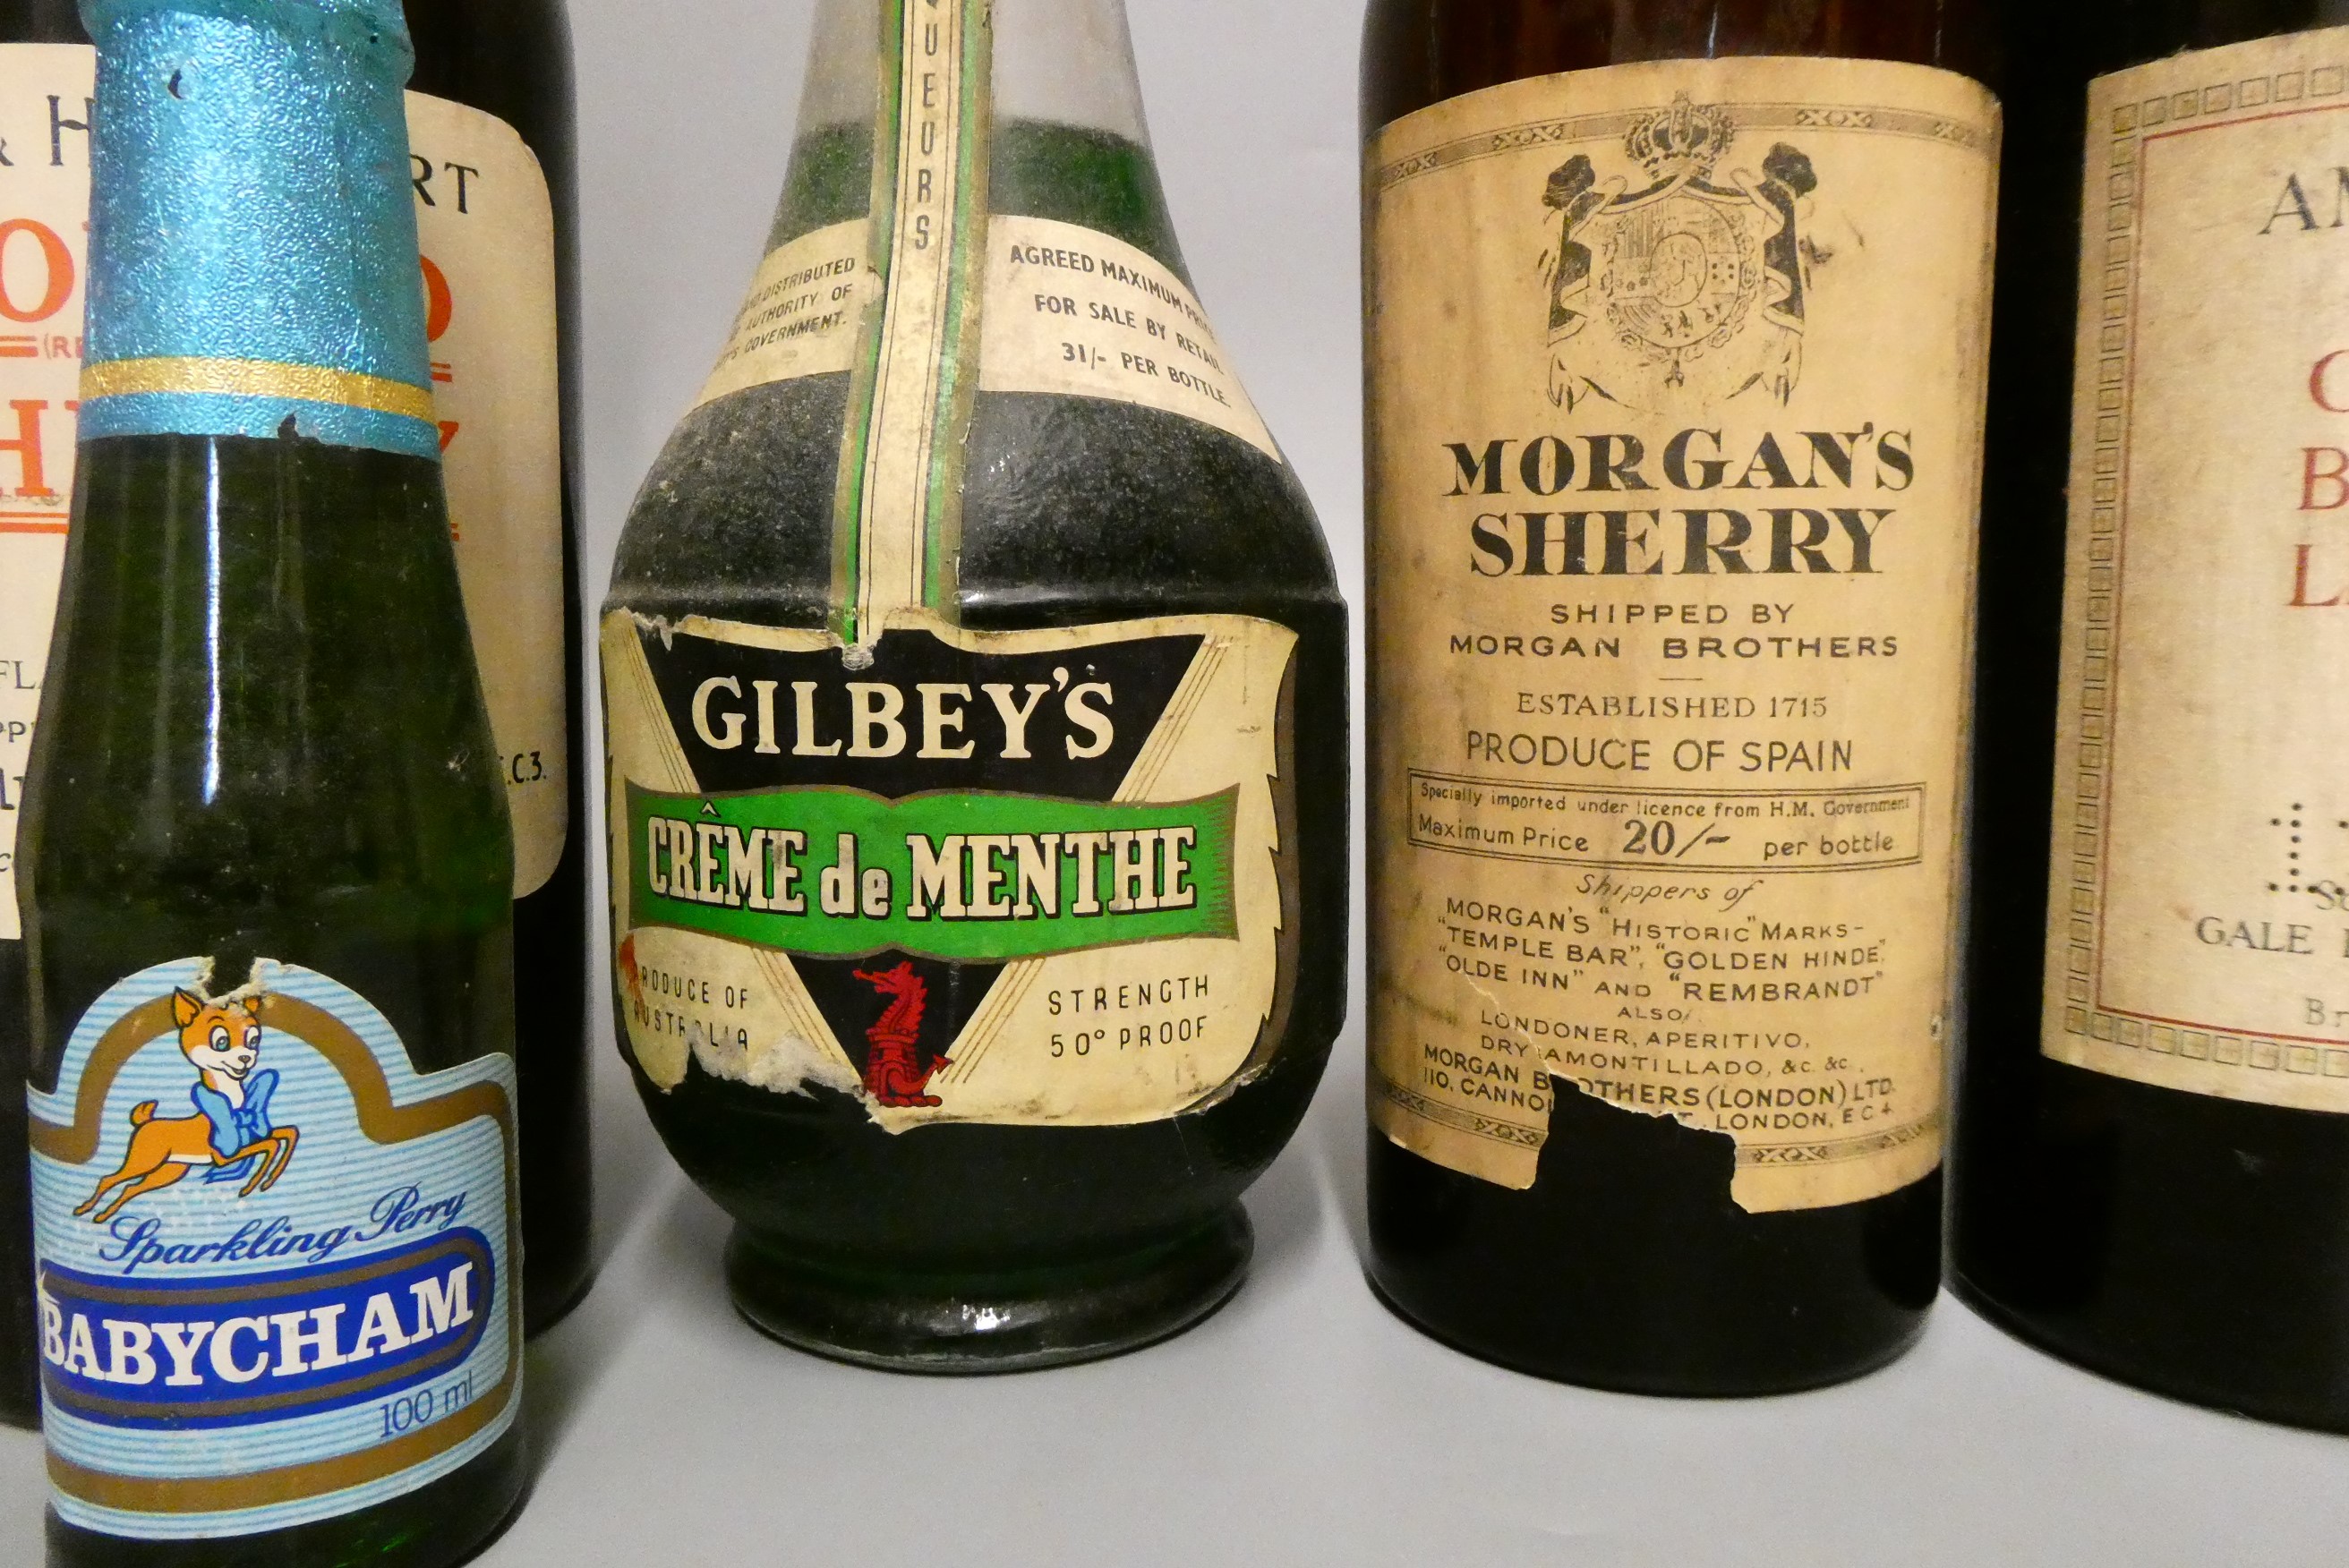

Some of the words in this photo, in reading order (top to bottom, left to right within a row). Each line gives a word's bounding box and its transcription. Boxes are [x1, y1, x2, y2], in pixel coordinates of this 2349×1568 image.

[914, 0, 939, 251] UEURS
[762, 257, 856, 303] DISTRIBUTED
[1010, 244, 1095, 273] AGREED
[1100, 259, 1183, 314] MAXIMUM
[746, 292, 818, 332] AUTHORITY
[831, 284, 853, 302] OF
[1034, 294, 1078, 317] FOR
[1089, 302, 1137, 328] SALE
[1146, 317, 1166, 340] BY
[1061, 342, 1106, 371] 31/-
[1120, 352, 1159, 377] PER
[1440, 421, 1915, 498] MORGAN'S
[1469, 507, 1896, 576] SHERRY
[1550, 603, 1728, 625] SHIPPED
[1751, 602, 1797, 624] BY
[1449, 635, 1621, 659] MORGAN
[1662, 635, 1899, 660] BROTHERS
[689, 665, 1115, 761] GILBEY'S
[1516, 692, 1755, 719] ESTABLISHED
[1768, 695, 1828, 718] 1715
[1466, 730, 1651, 771] PRODUCE
[1672, 738, 1725, 772] OF
[1739, 739, 1853, 772] SPAIN
[1421, 781, 1482, 807] Specially
[1491, 789, 1567, 812] imported
[1577, 799, 1629, 814] under
[1636, 798, 1706, 818] licence
[1714, 802, 1761, 818] from
[1769, 801, 1815, 818] H.M.
[1823, 797, 1910, 817] Government
[1418, 814, 1515, 846] Maximum
[1523, 826, 1590, 853] Price
[1622, 818, 1731, 859] 20/-
[1763, 841, 1808, 861] per
[1819, 831, 1894, 856] bottle
[645, 802, 808, 913] CRÊME
[821, 831, 893, 921] de
[905, 823, 1199, 923] MENTHE
[1446, 897, 1591, 934] MORGAN'S
[1576, 873, 1711, 904] Shippers
[1718, 879, 1764, 913] of
[1438, 916, 1555, 960] "TEMPLE
[1656, 942, 1788, 971] "GOLDEN
[2194, 916, 2315, 955] GALE
[1048, 974, 1209, 1016] STRENGTH
[1439, 944, 1508, 982] "OLDE
[1522, 967, 1585, 991] INN"
[1593, 981, 1653, 998] AND
[1668, 969, 1884, 1002] "REMBRANDT"
[725, 985, 748, 1010] OF
[1051, 1029, 1106, 1058] 50°
[1120, 1015, 1208, 1051] PROOF
[1480, 1010, 1637, 1049] LONDONER,
[1645, 1031, 1811, 1050] APERITIVO,
[1423, 1043, 1520, 1084] MORGAN
[1533, 1069, 1701, 1107] BOTHERS
[1705, 1078, 1848, 1112] (LONDON)
[1481, 1034, 1529, 1058] DRY
[1544, 1048, 1772, 1078] AMONTILLADO,
[98, 1214, 349, 1276] Sparkling
[354, 1180, 469, 1244] Perry
[40, 1261, 476, 1386] BABYCHAM
[379, 1387, 436, 1439] 100
[442, 1370, 475, 1417] ml
